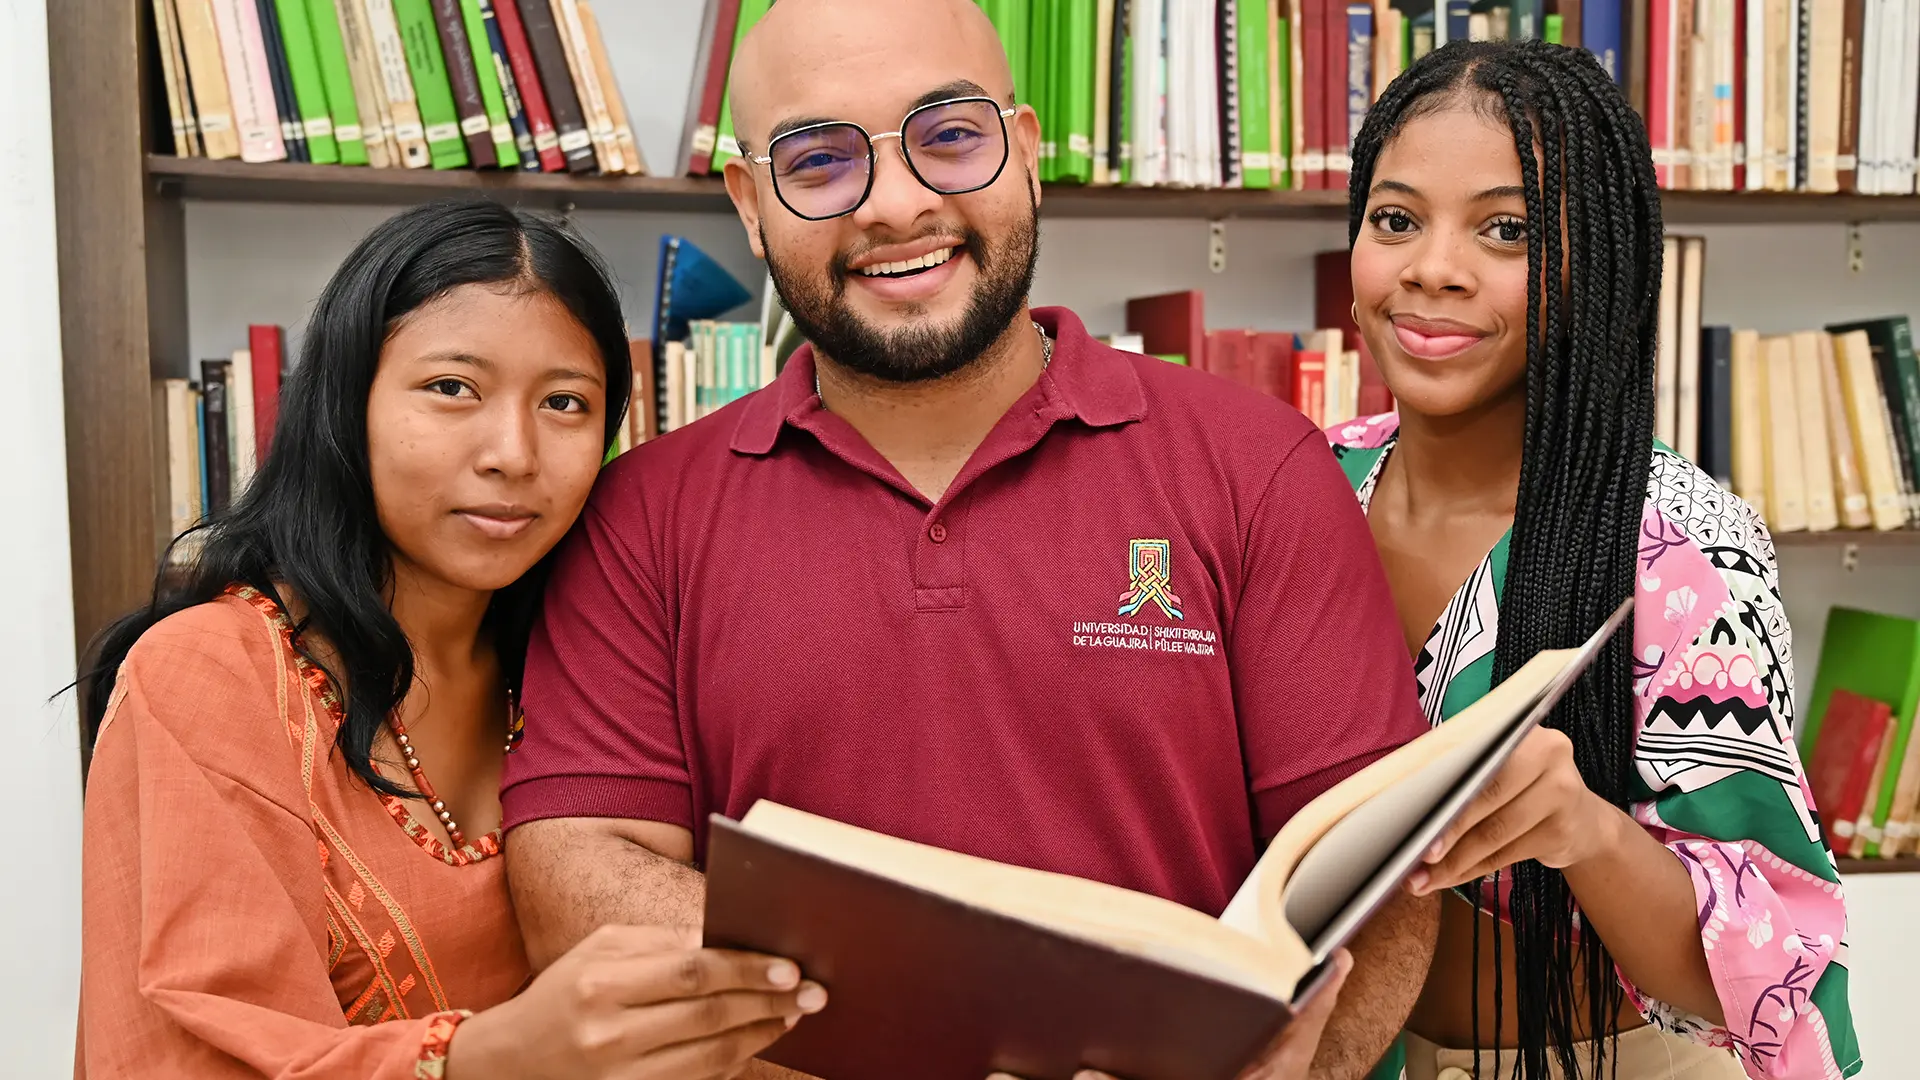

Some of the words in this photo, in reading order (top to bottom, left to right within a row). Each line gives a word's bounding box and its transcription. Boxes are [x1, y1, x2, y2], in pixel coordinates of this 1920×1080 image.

[1073, 621, 1148, 636] UNIVERSIDAD
[1073, 635, 1087, 646] DE
[1089, 635, 1102, 646] LA
[1103, 635, 1148, 650] GUAJIRA
